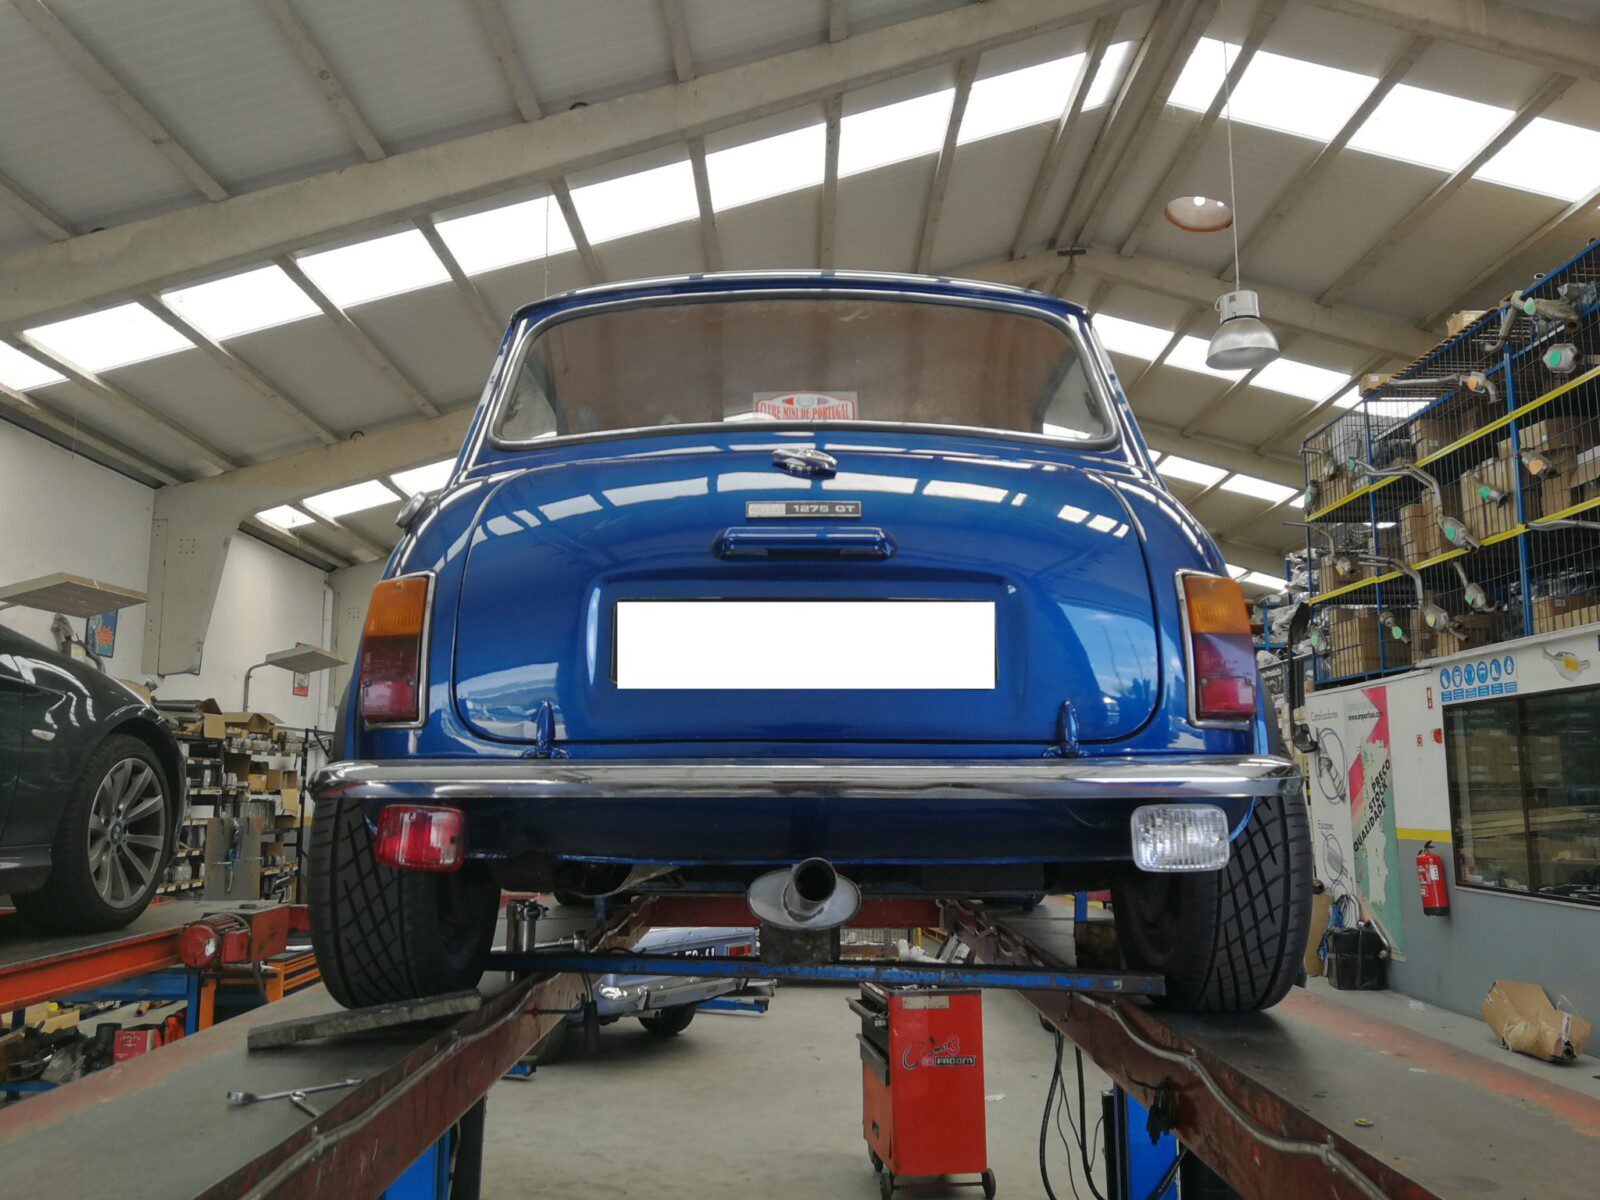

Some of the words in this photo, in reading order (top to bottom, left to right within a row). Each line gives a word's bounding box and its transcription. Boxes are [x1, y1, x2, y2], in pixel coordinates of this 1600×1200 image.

[793, 505, 829, 513] 1275
[835, 505, 856, 513] GT
[1368, 780, 1388, 813] STOCK
[1353, 800, 1387, 852] QUALIDADE
